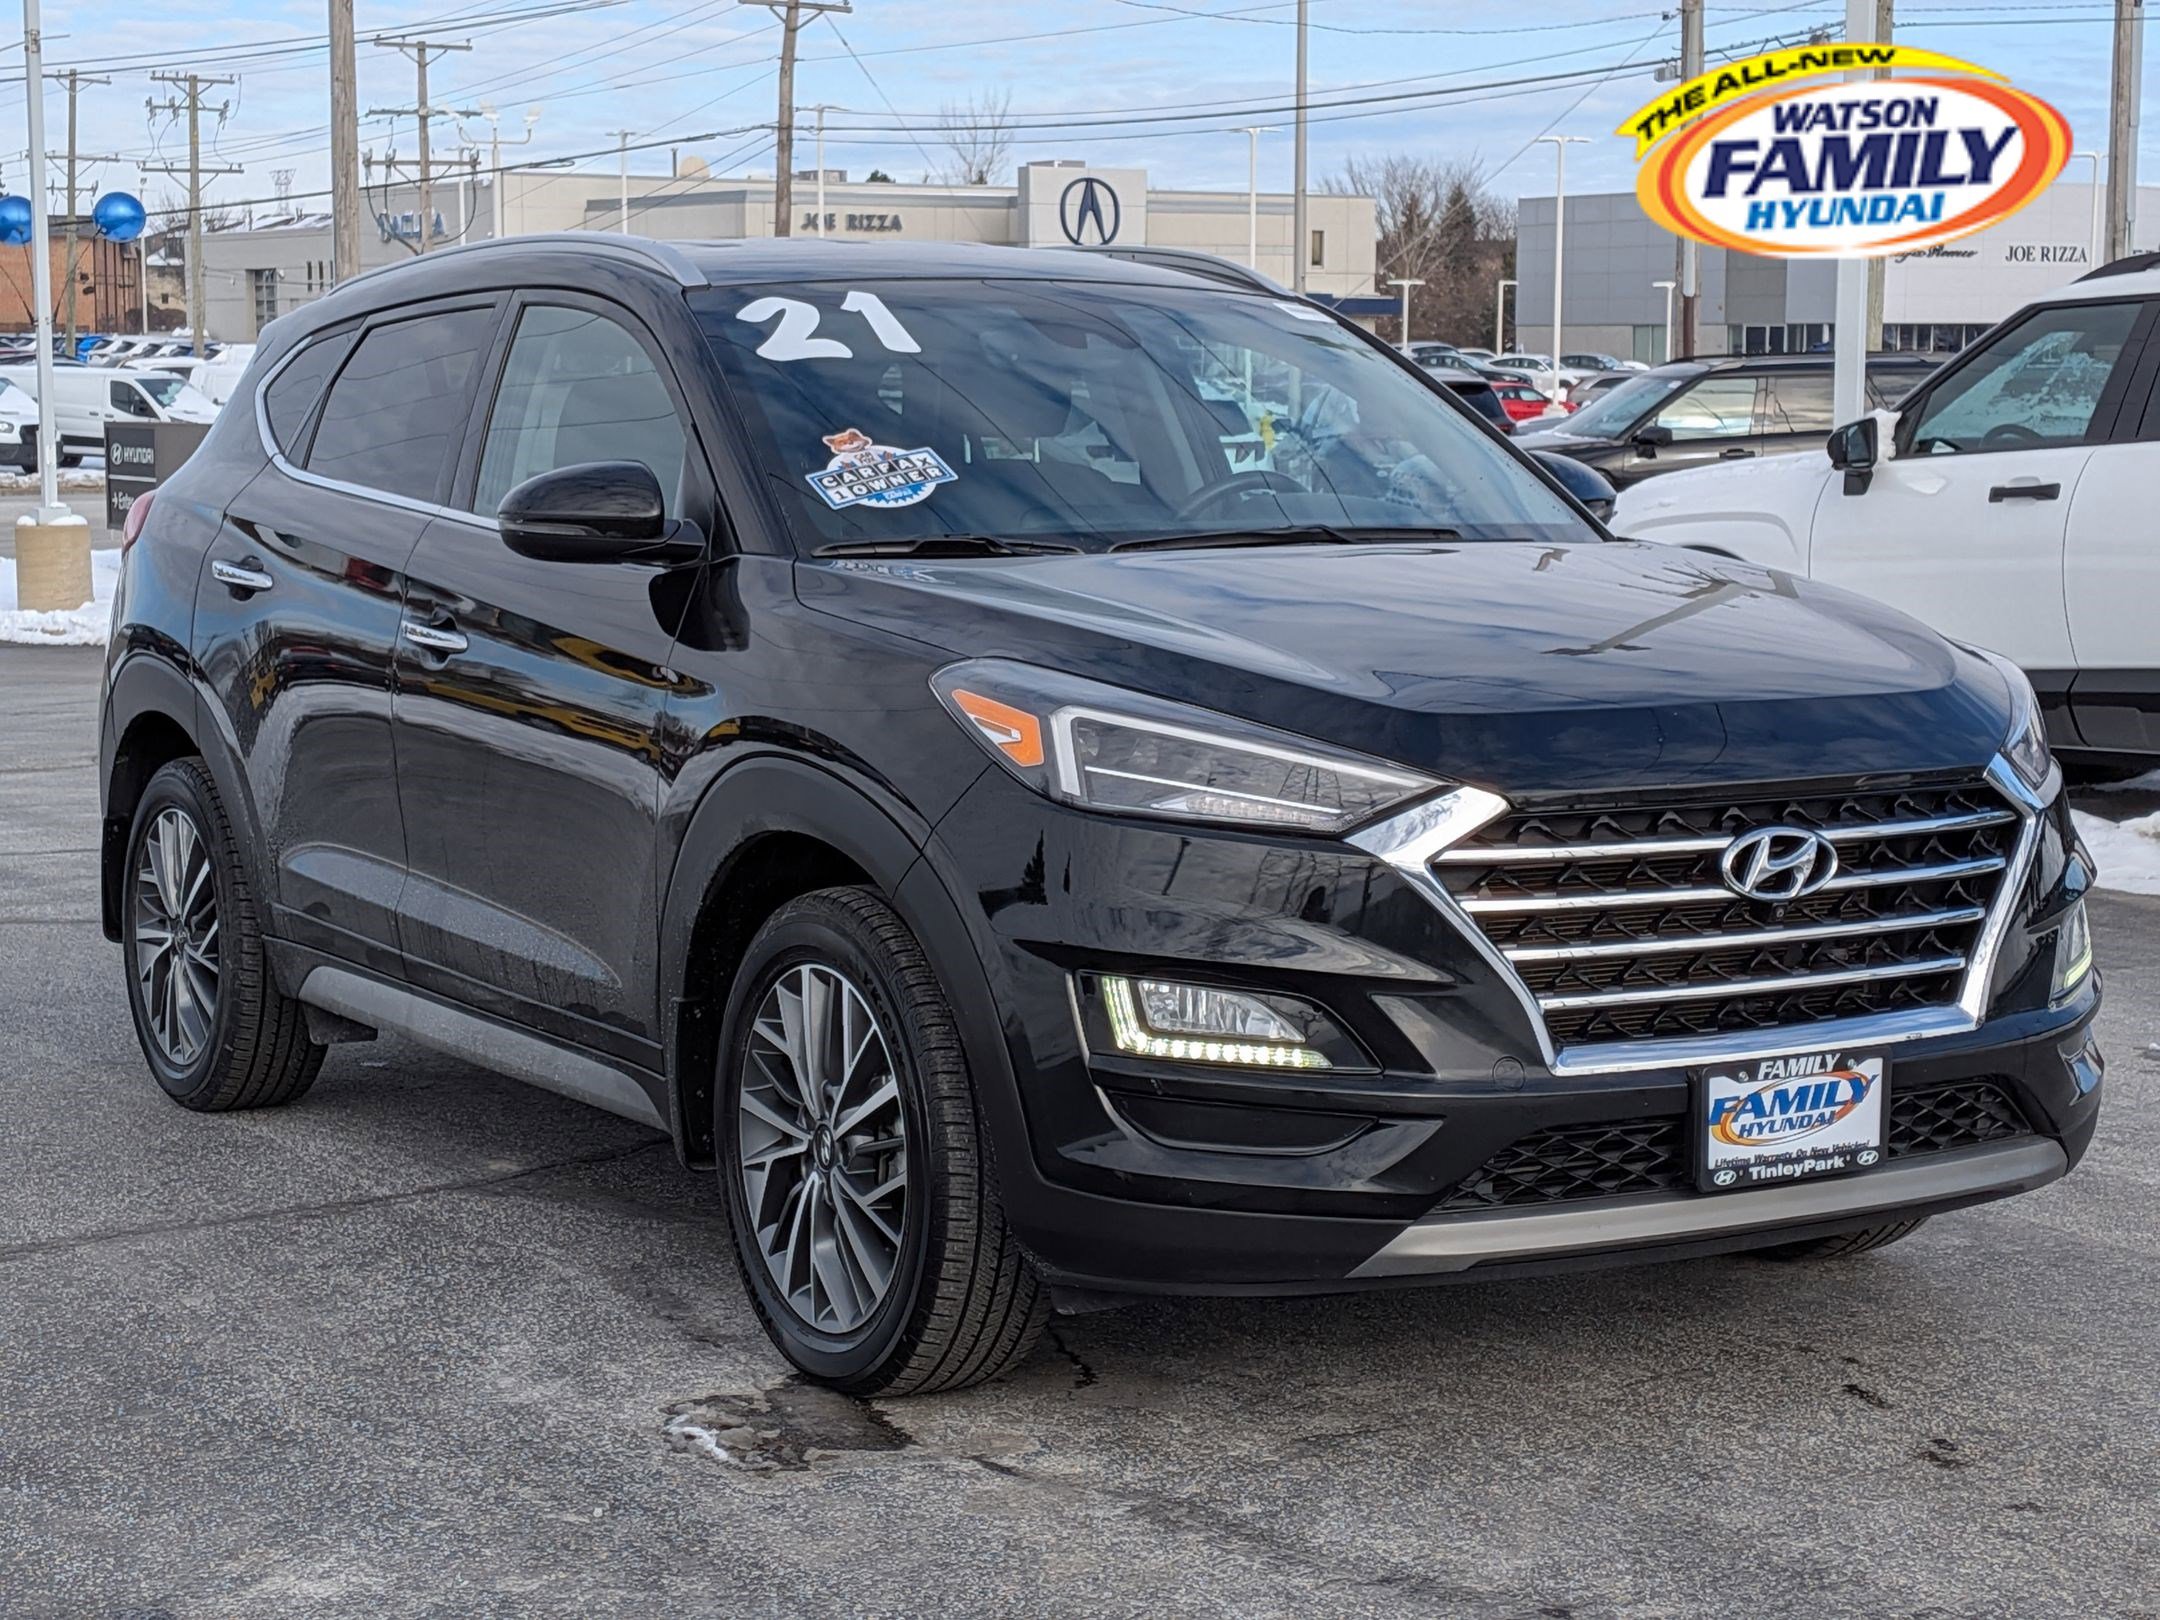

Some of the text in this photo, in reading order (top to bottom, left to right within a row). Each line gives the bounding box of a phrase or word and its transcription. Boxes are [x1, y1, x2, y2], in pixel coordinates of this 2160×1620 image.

[846, 213, 903, 232] RIZZA
[2005, 245, 2088, 263] JOE RIZZA
[735, 290, 922, 361] 21
[123, 447, 154, 464] HYUNDAI
[821, 456, 933, 488] CARFAX
[852, 467, 943, 496] OWNER
[1757, 1053, 1841, 1081] FAMILY
[1708, 1074, 1880, 1126] FAMILY
[1738, 1110, 1837, 1139] HYUNDAI
